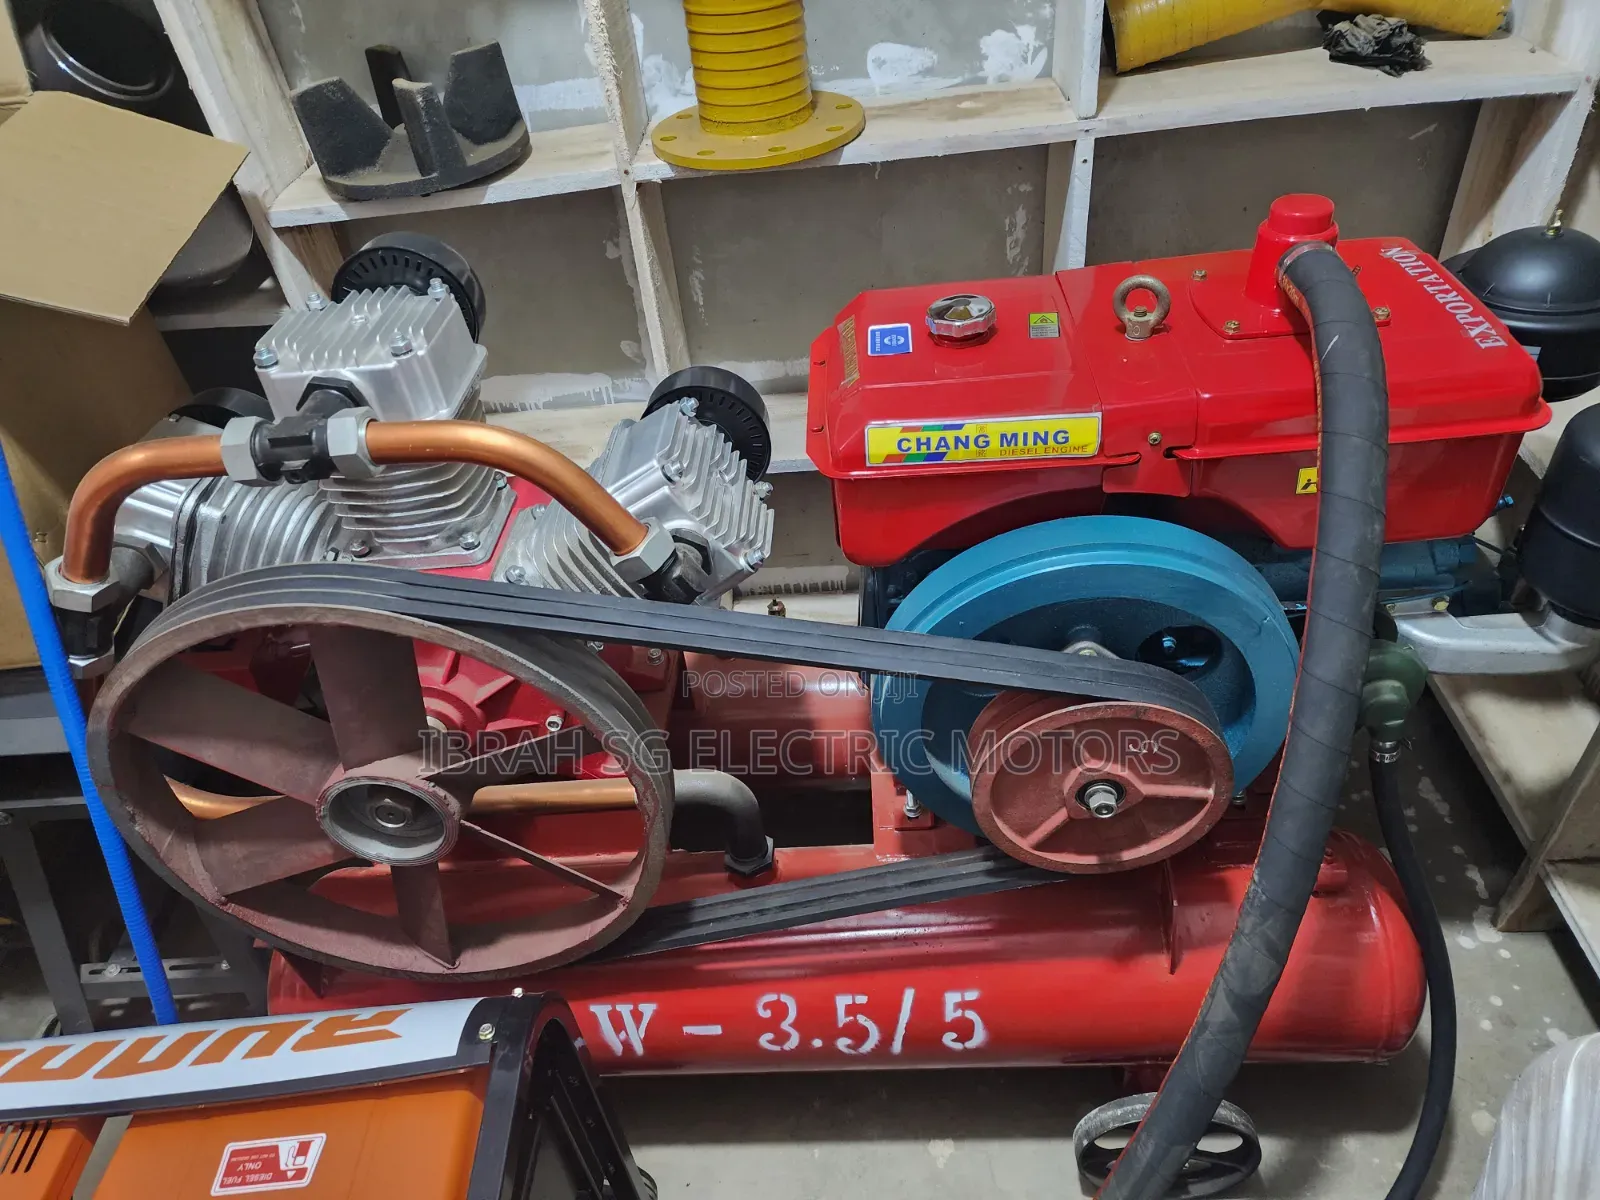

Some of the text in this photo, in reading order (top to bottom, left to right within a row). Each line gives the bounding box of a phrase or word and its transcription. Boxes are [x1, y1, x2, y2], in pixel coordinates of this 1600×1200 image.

[1380, 247, 1508, 349] EXPORTATION
[897, 434, 991, 453] CHANG
[1000, 430, 1070, 448] MING
[1000, 446, 1088, 456] DIESEL ENGINE
[237, 1161, 262, 1172] ONLY
[223, 1173, 273, 1185] DIESEL FUEL
